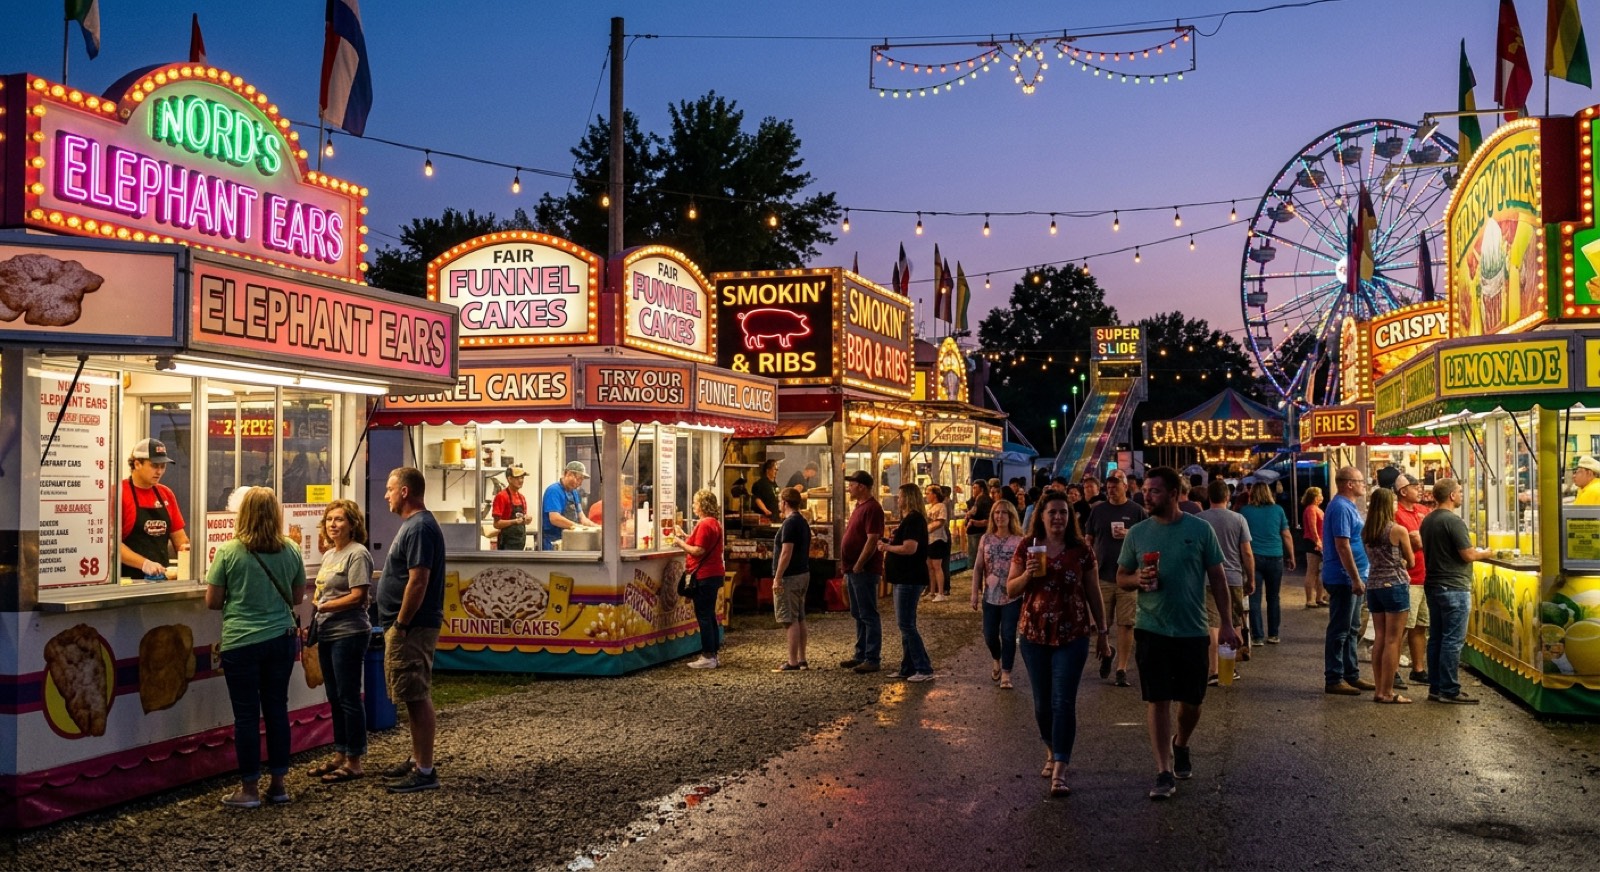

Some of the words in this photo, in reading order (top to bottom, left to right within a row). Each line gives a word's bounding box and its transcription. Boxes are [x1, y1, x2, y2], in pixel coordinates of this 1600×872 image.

[153, 95, 283, 175] NORD'S
[58, 131, 259, 243] ELEPHANT
[264, 191, 345, 264] EARS
[493, 249, 534, 264] FAIR
[449, 265, 580, 298] FUNNEL
[657, 262, 679, 282] FAIR
[632, 271, 701, 319] FUNNEL
[722, 280, 826, 307] SMOKIN'
[200, 274, 374, 355] ELEPHANT
[379, 311, 447, 368] EARS
[460, 299, 568, 330] CAKES
[638, 307, 696, 347] CAKES
[849, 287, 906, 341] SMOKIN'
[1096, 328, 1140, 340] SUPER
[1374, 311, 1449, 349] CRISPY
[731, 353, 750, 373] &
[758, 352, 817, 373] RIBS
[847, 332, 873, 381] BBQ
[874, 343, 884, 377] &
[885, 344, 908, 385] RIBS
[1098, 342, 1137, 354] SLIDE
[599, 369, 640, 386] TRY
[643, 371, 682, 387] OUR
[1444, 347, 1561, 389] LEMONADE
[486, 372, 567, 401] CAKES
[597, 385, 684, 404] FAMOUS!
[699, 378, 741, 409] FUNNEL
[1152, 419, 1271, 443] CAROUSEL
[1315, 414, 1355, 433] FRIES
[79, 557, 99, 578] $8
[450, 619, 508, 634] FUNNEL
[512, 619, 560, 636] CAKES
